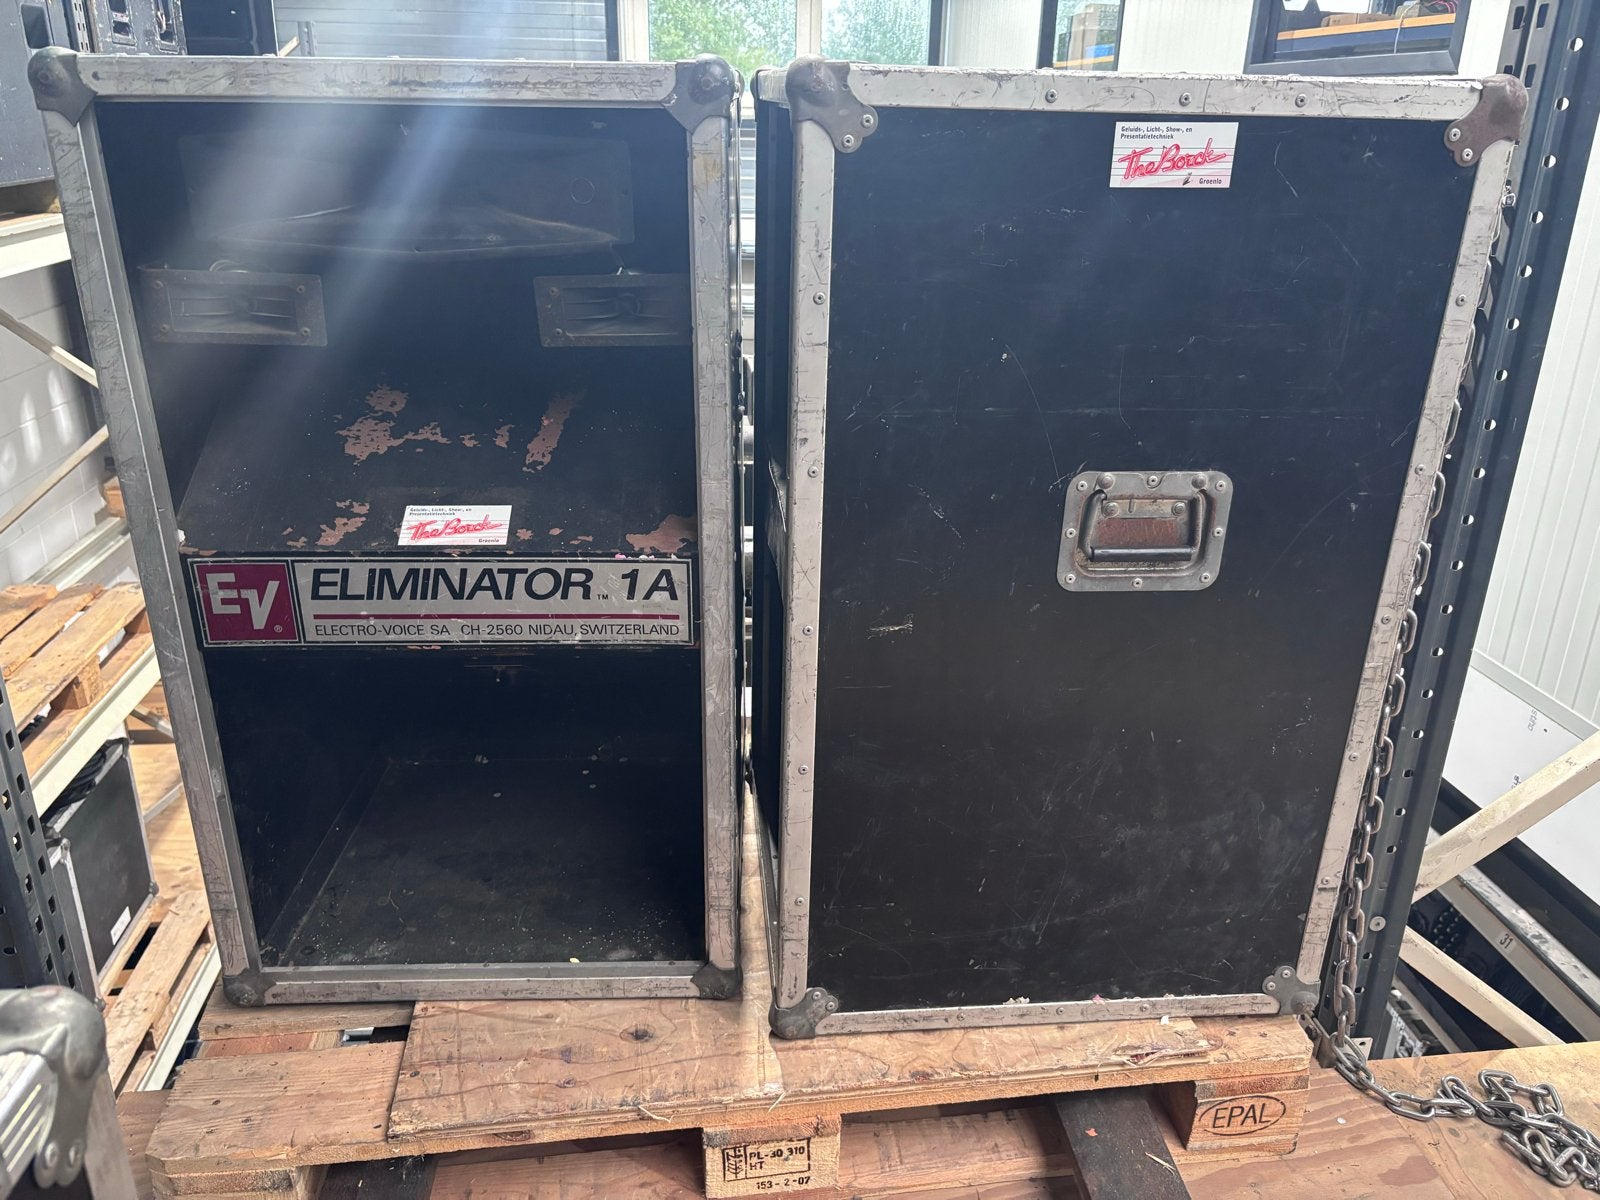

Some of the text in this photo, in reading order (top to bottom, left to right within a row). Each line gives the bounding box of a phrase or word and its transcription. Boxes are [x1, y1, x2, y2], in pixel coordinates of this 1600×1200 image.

[310, 567, 594, 601] ELIMINATOR
[621, 568, 679, 601] 1A
[205, 572, 280, 630] EV
[315, 624, 680, 638] ELECTRO-VOICE SA CH-2560 NIDAU, SWITZERLAND
[1499, 933, 1514, 949] 31
[1212, 1102, 1271, 1129] EPAL
[749, 1161, 765, 1171] HT
